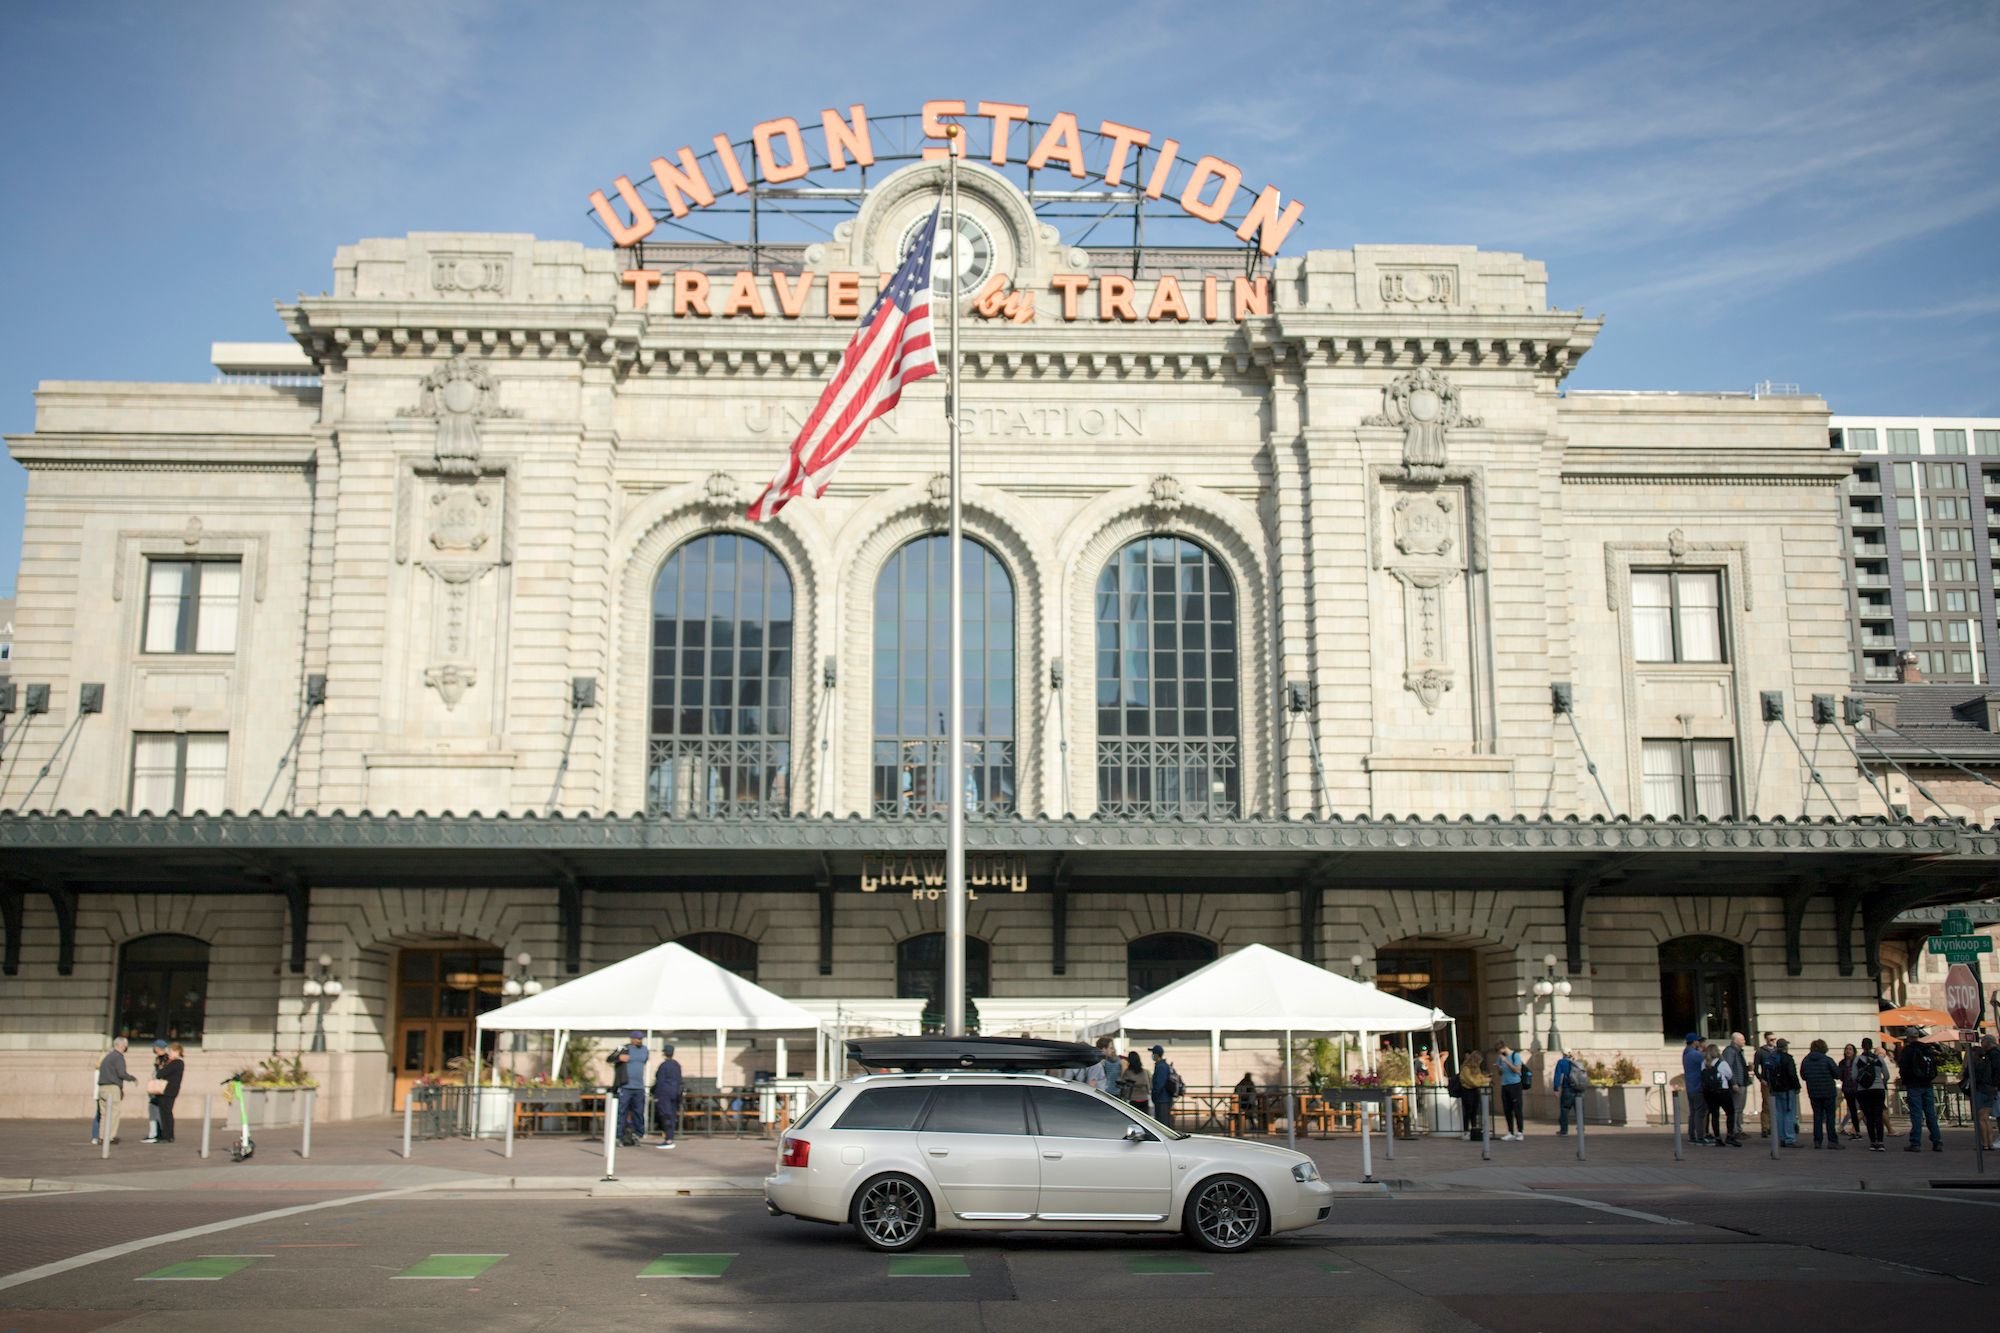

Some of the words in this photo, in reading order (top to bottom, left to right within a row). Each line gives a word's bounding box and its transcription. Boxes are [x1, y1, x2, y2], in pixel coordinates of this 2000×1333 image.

[588, 104, 875, 248] UNION
[921, 99, 1305, 257] STATION
[973, 272, 1035, 324] by
[1052, 273, 1274, 322] TRAIN
[743, 405, 898, 435] UNN
[957, 407, 1145, 437] STATION
[861, 855, 1028, 892] CRAWORD
[912, 889, 979, 900] HOL
[1931, 938, 1980, 952] Wynkoop
[1947, 985, 1976, 1009] STOP
